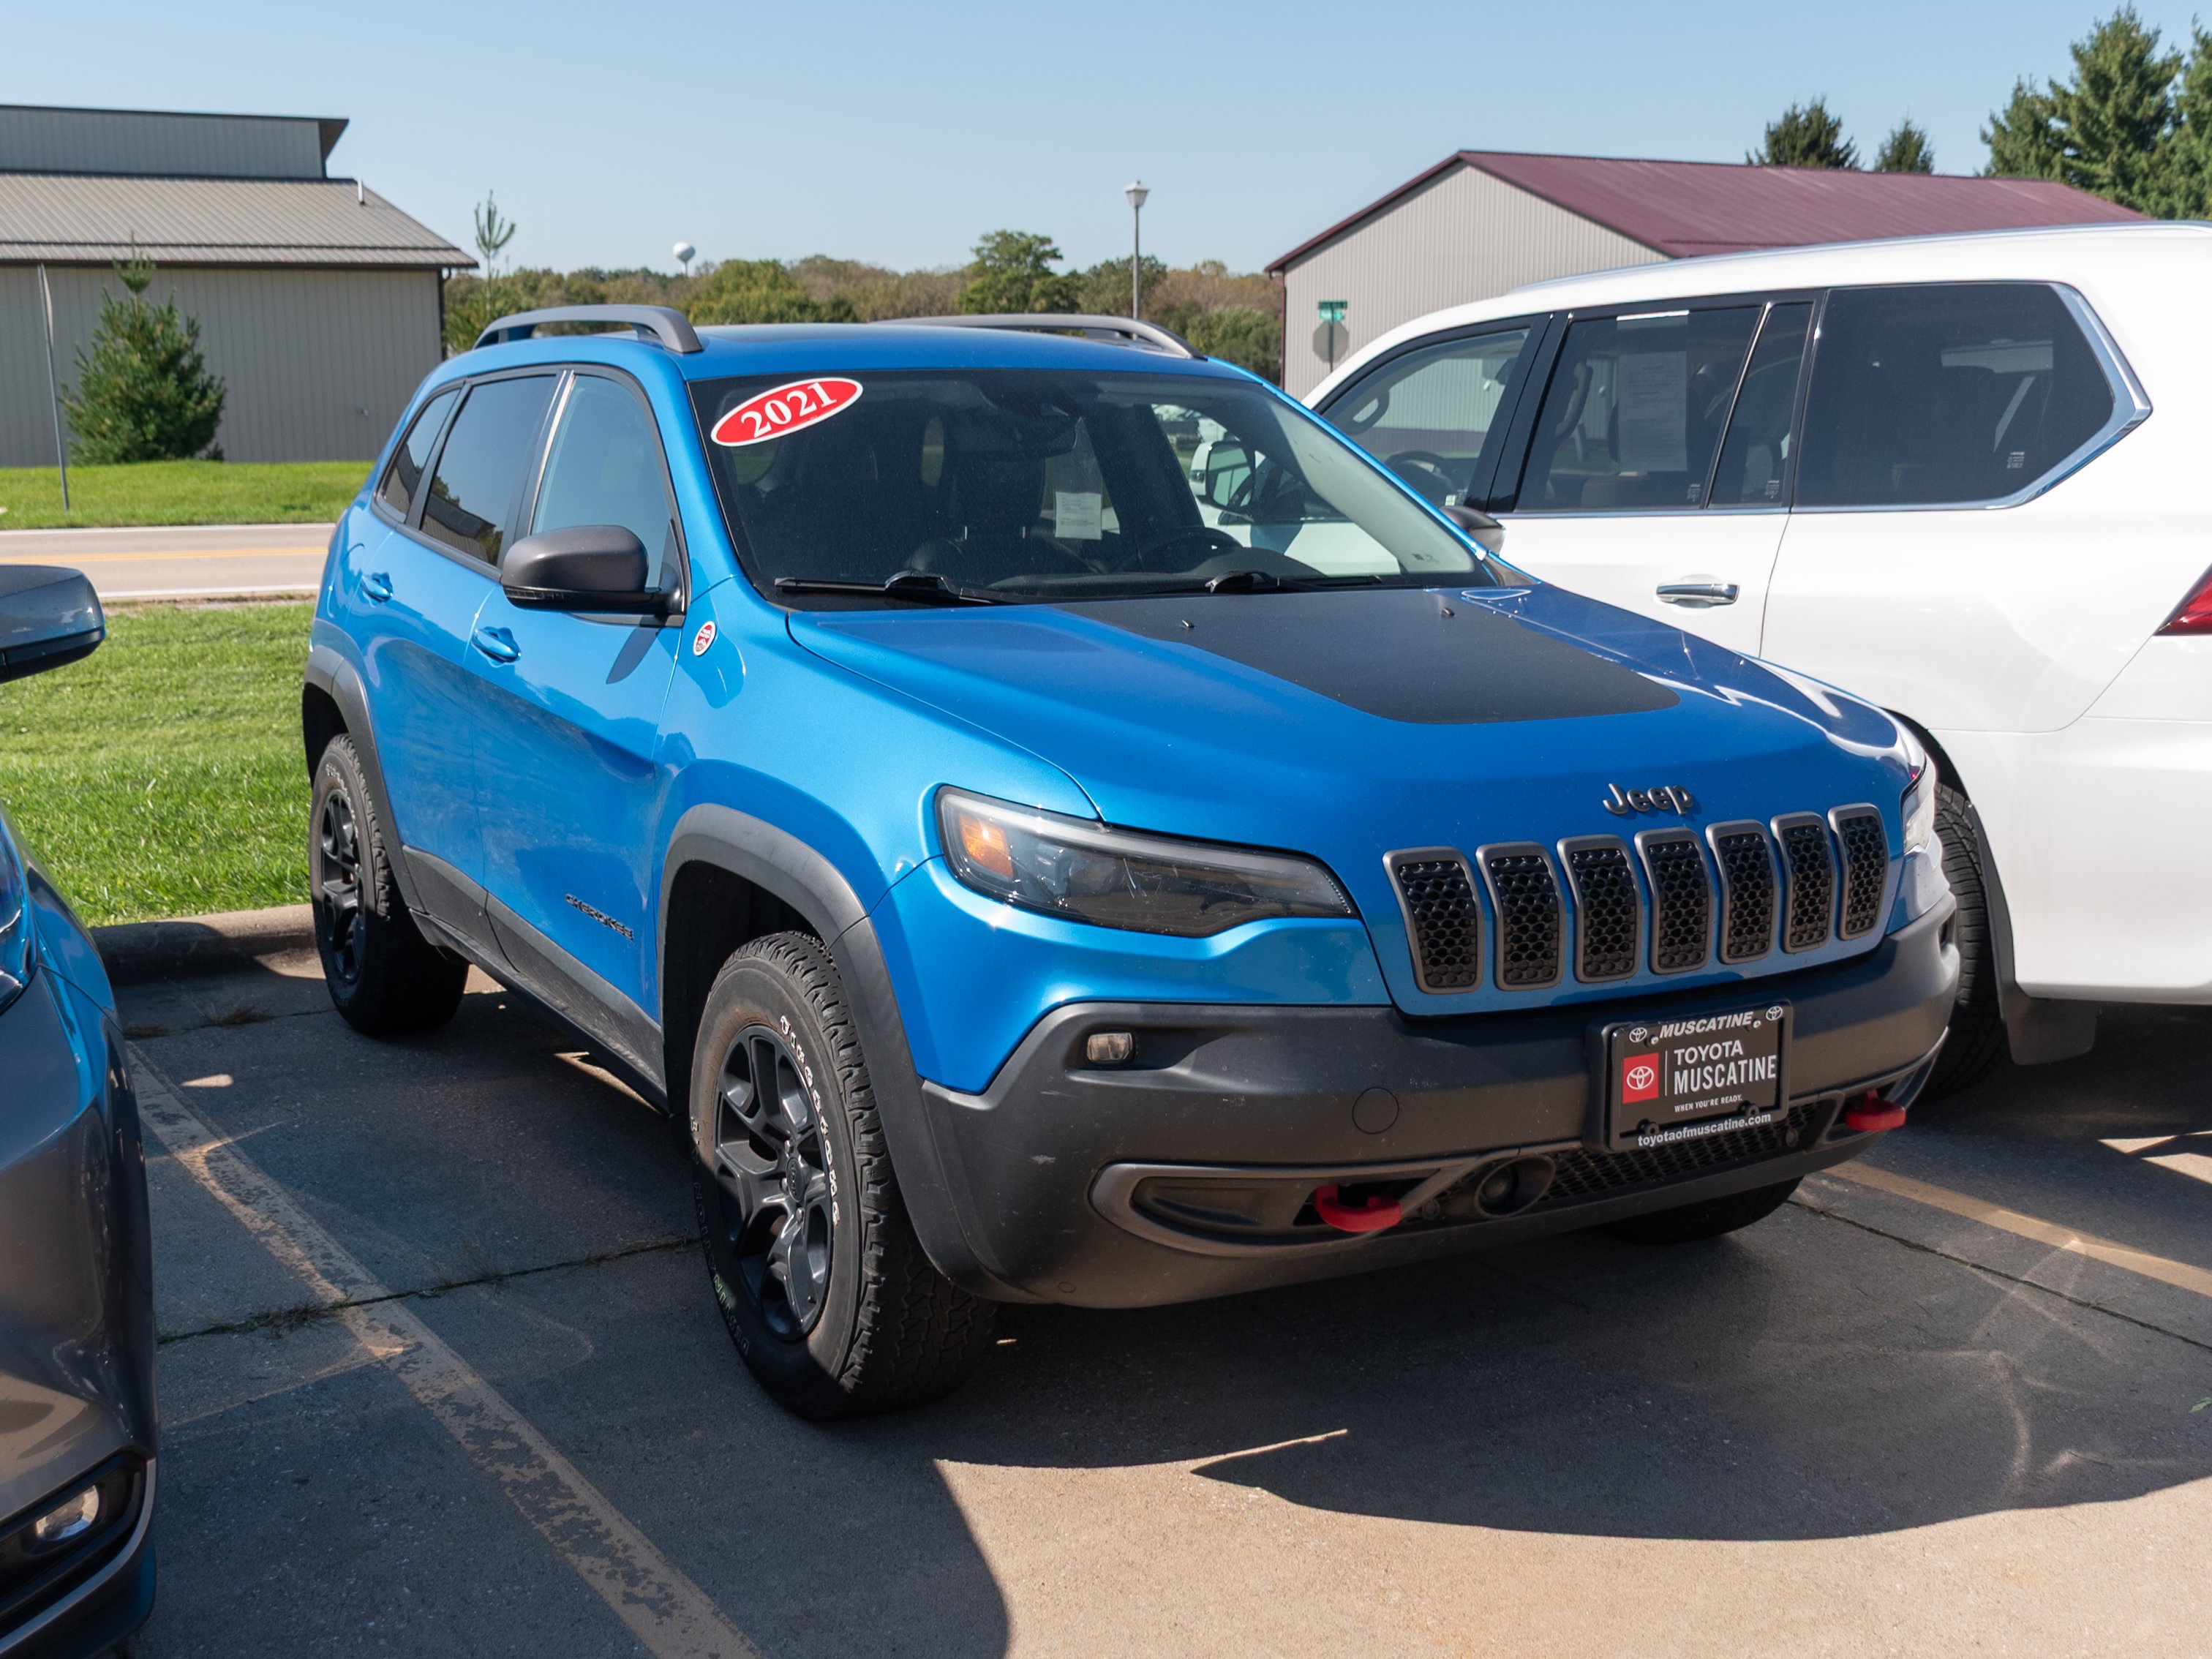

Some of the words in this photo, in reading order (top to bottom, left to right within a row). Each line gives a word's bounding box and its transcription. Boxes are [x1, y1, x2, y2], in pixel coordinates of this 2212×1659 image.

[741, 382, 837, 438] 2021
[1603, 783, 1693, 815] Jeep
[1659, 1011, 1754, 1039] MUSCATINE
[1674, 1039, 1744, 1065] TOYOTA
[1674, 1055, 1778, 1095] MUSCATINE
[1674, 1103, 1693, 1113] WHEN
[1695, 1098, 1719, 1110] YOU'RE
[1720, 1094, 1743, 1106] READY.
[1638, 1113, 1772, 1147] toyotaofmuscatine.com
